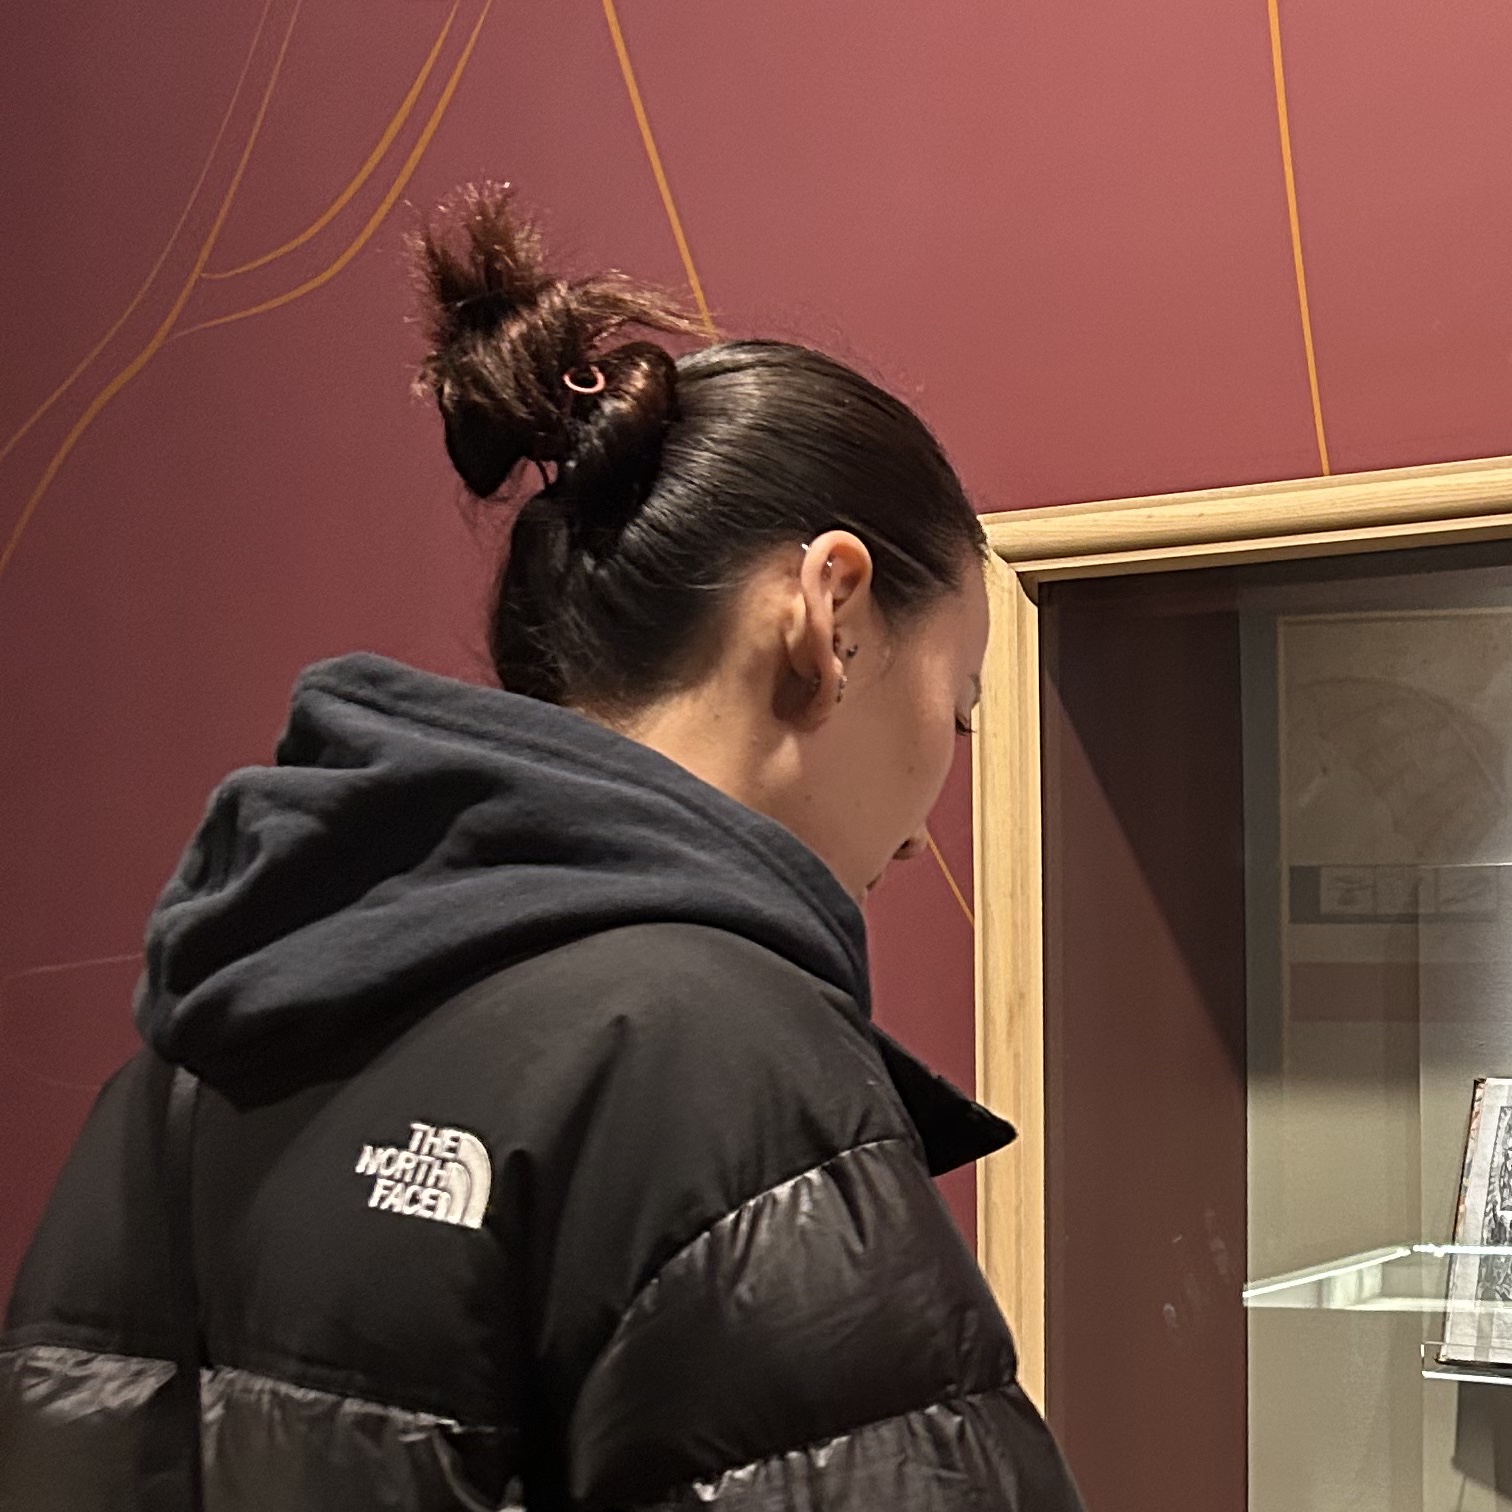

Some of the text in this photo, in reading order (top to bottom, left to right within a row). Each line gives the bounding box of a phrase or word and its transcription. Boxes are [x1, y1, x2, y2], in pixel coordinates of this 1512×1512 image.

[409, 1122, 460, 1159] THE
[355, 1144, 448, 1188] NORTH
[368, 1177, 438, 1218] FACE
